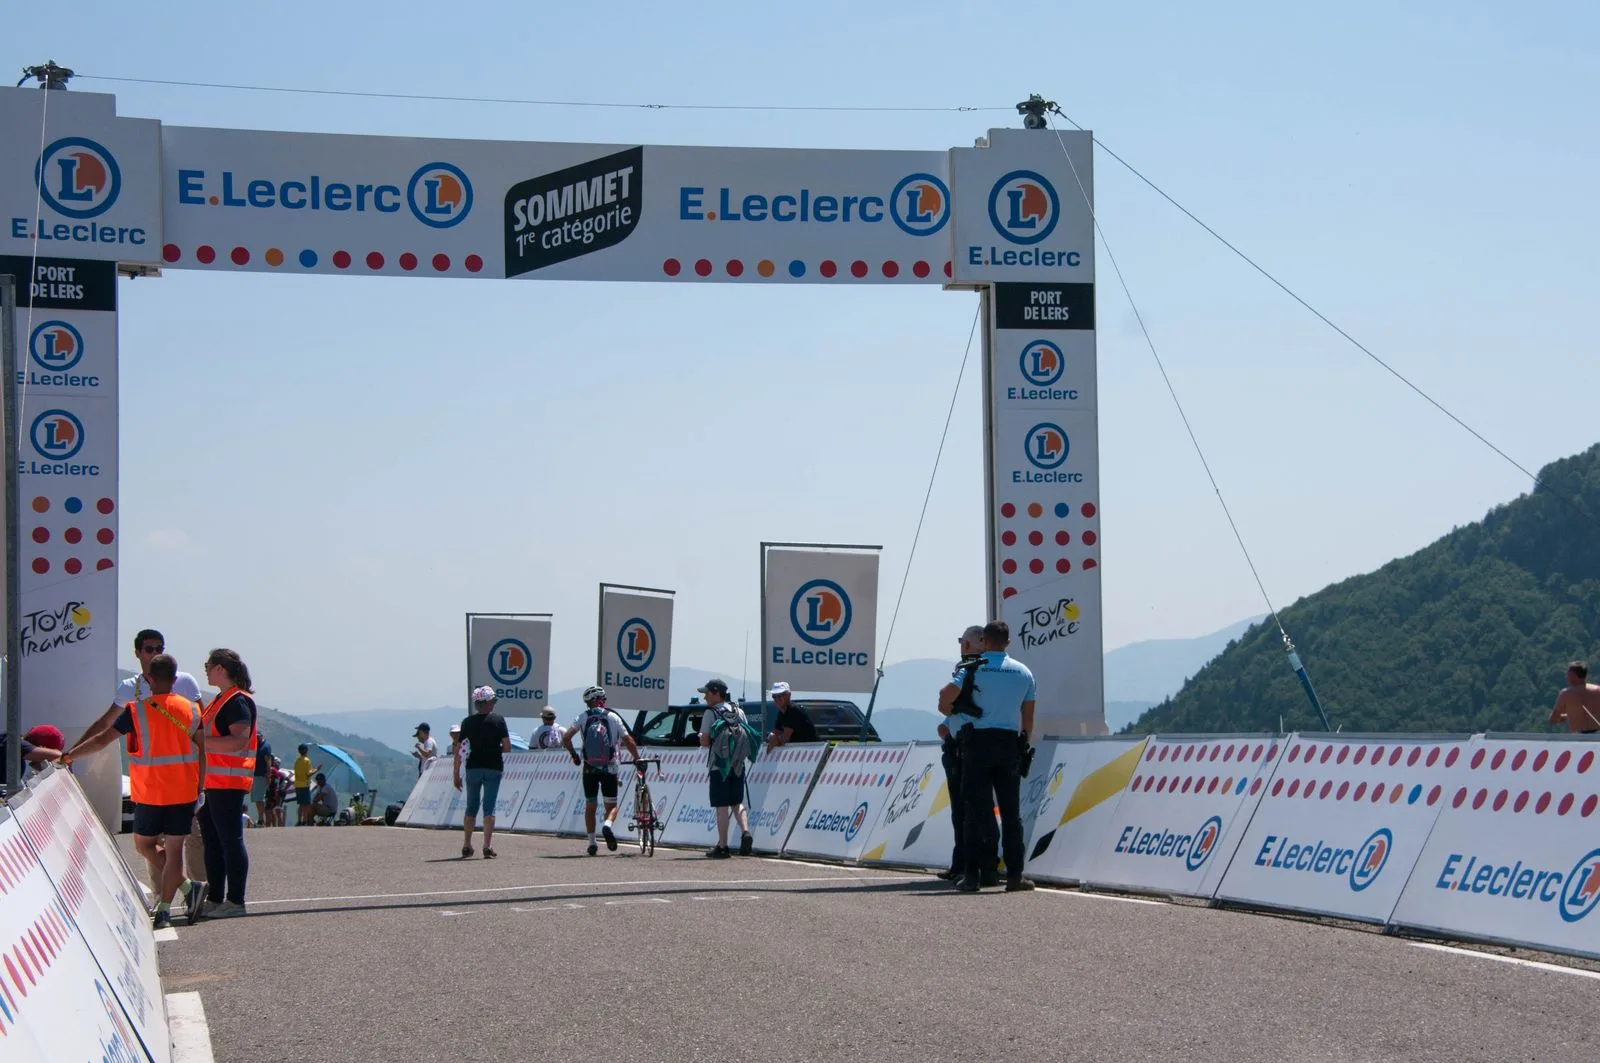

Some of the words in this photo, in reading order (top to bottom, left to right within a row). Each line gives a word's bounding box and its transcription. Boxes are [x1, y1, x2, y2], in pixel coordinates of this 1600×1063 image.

[178, 169, 401, 213] E.Leclerc
[513, 166, 634, 232] SOMMET
[679, 186, 885, 223] E.Leclerc
[11, 217, 146, 245] E.Leclerc
[515, 231, 536, 257] 1re
[541, 204, 632, 250] catégorie
[968, 246, 1081, 267] E.Leclerc
[37, 265, 76, 282] PORT
[29, 282, 48, 298] DE
[50, 284, 84, 300] LERS
[1030, 290, 1062, 305] PORT
[1024, 306, 1039, 320] DE
[1041, 306, 1069, 321] LERS
[16, 371, 100, 387] E.Leclerc
[1007, 386, 1078, 400] E.Leclerc
[1012, 470, 1084, 484] E.Leclerc
[63, 621, 74, 632] de
[772, 646, 869, 666] E.Leclerc
[604, 671, 665, 691] E.Leclerc
[475, 684, 544, 700] eclerc
[805, 809, 850, 832] E.Leclerc
[1114, 825, 1192, 858] E.Leclerc
[1254, 835, 1354, 875] E.Leclerc
[1435, 853, 1564, 902] E.Leclerc
